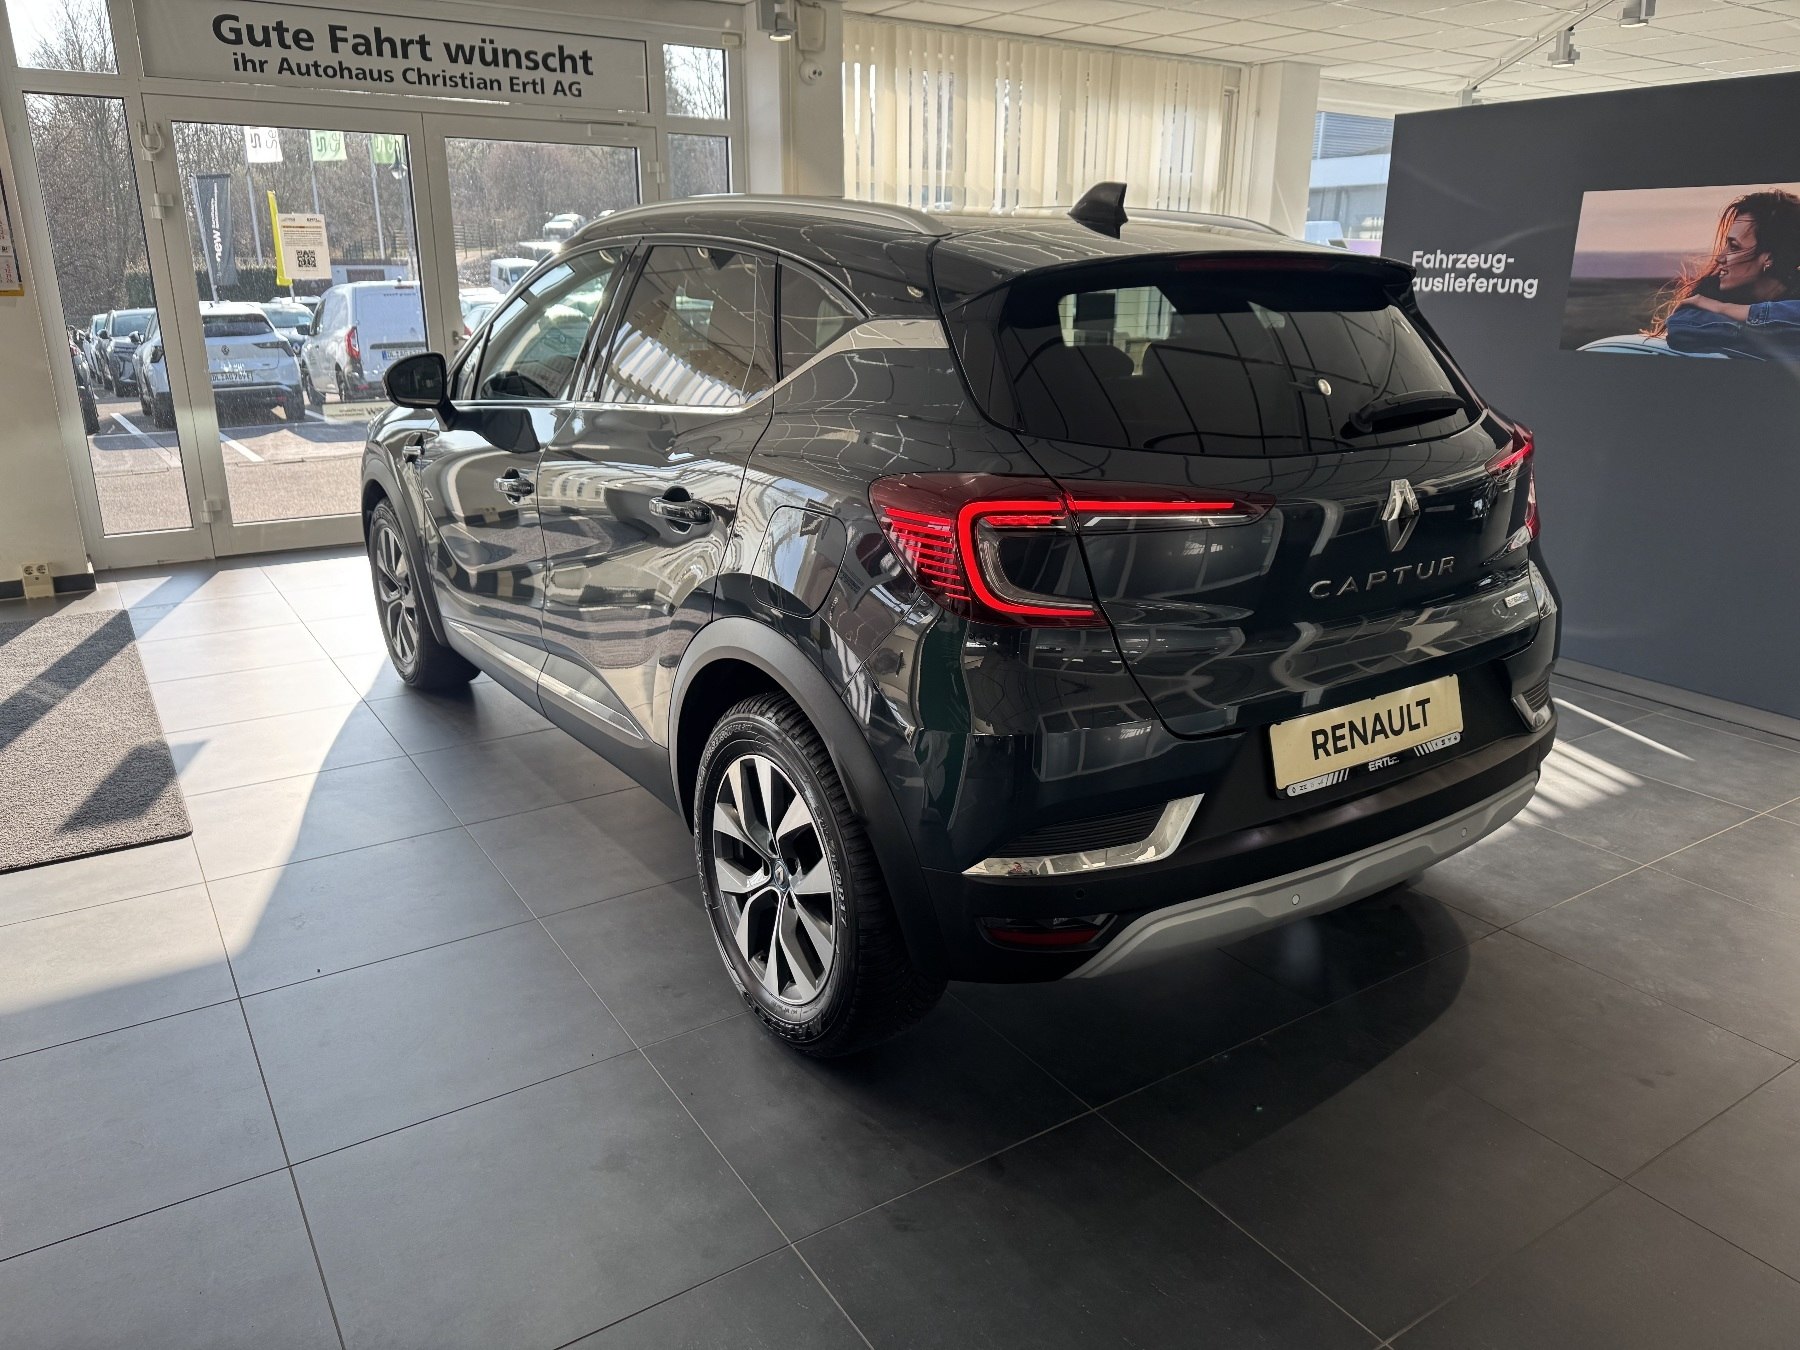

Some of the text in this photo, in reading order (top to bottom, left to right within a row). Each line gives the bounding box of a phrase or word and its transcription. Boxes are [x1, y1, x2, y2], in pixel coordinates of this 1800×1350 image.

[211, 13, 594, 76] Gute Fahrt wünscht
[232, 51, 582, 98] ihr Autohaus Christian Ertl AG
[1411, 249, 1515, 273] Fahrzeug-
[1411, 273, 1539, 299] auslieferung
[1308, 556, 1456, 600] CAPTUR
[1310, 697, 1431, 761] RENAULT
